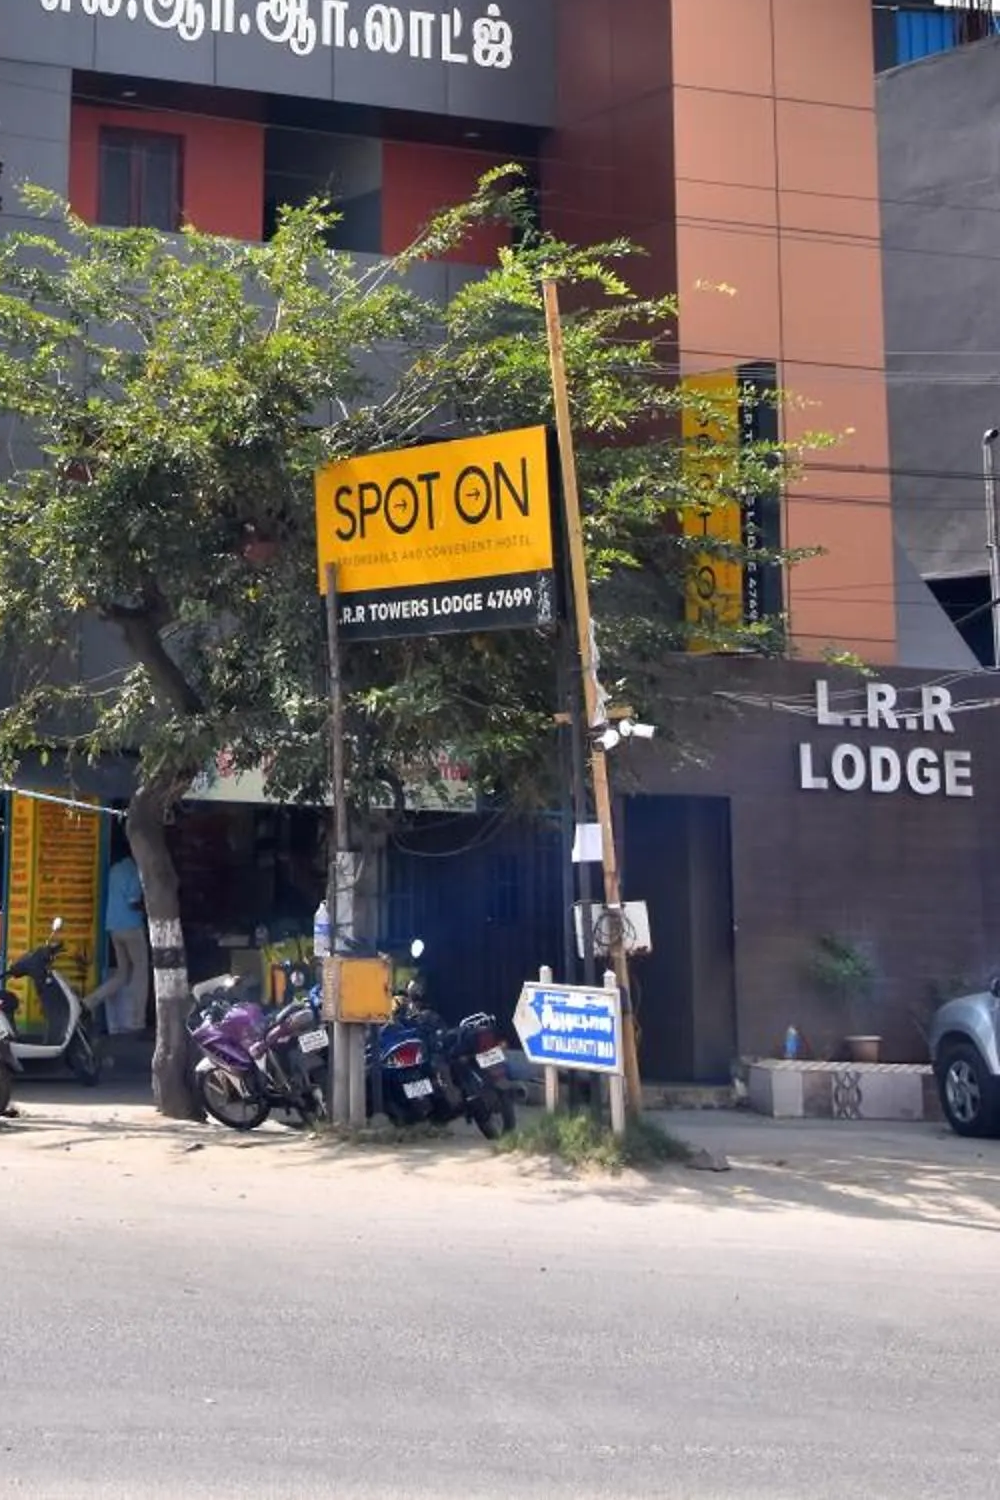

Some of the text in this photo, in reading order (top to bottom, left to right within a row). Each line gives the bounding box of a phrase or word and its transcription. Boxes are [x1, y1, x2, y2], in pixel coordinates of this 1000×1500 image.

[334, 457, 529, 541] SPOT ON
[370, 599, 429, 622] TOWERS
[433, 592, 483, 616] LODGE
[487, 587, 533, 610] 47699
[816, 679, 956, 733] L.R.R
[800, 742, 974, 797] LODGE
